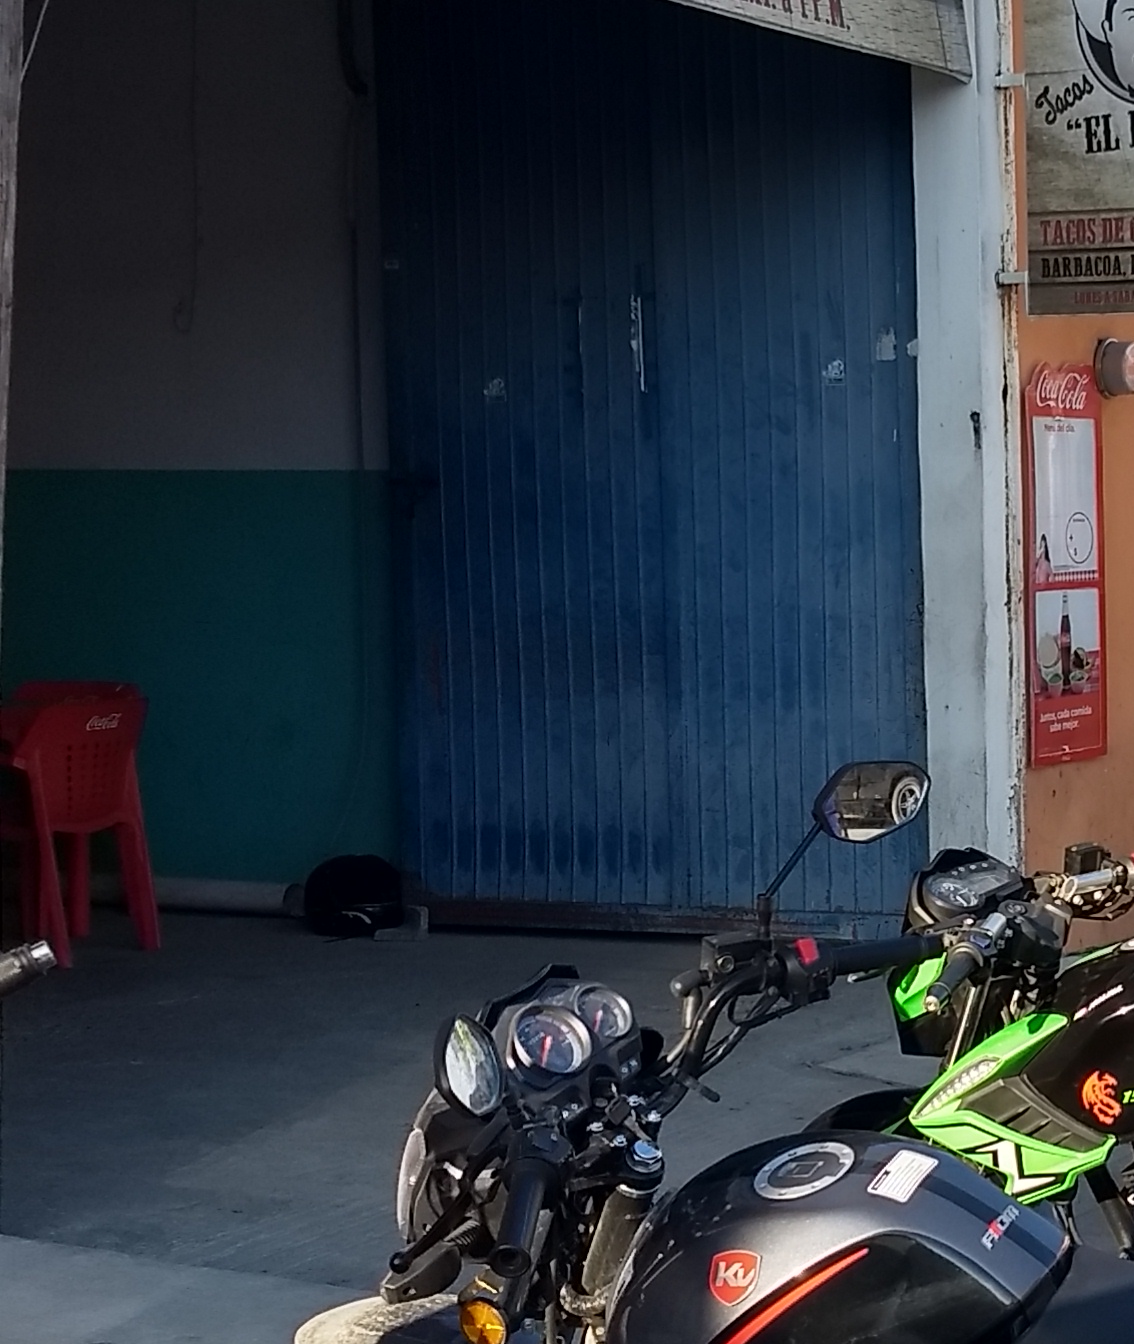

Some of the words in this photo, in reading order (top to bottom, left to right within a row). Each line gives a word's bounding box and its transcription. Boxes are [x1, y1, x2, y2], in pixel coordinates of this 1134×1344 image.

[1036, 74, 1095, 126] Tacos
[1066, 112, 1121, 155] “EL
[1039, 217, 1097, 247] TACOS
[1101, 216, 1125, 244] DE
[1041, 254, 1127, 279] BARBACOA,
